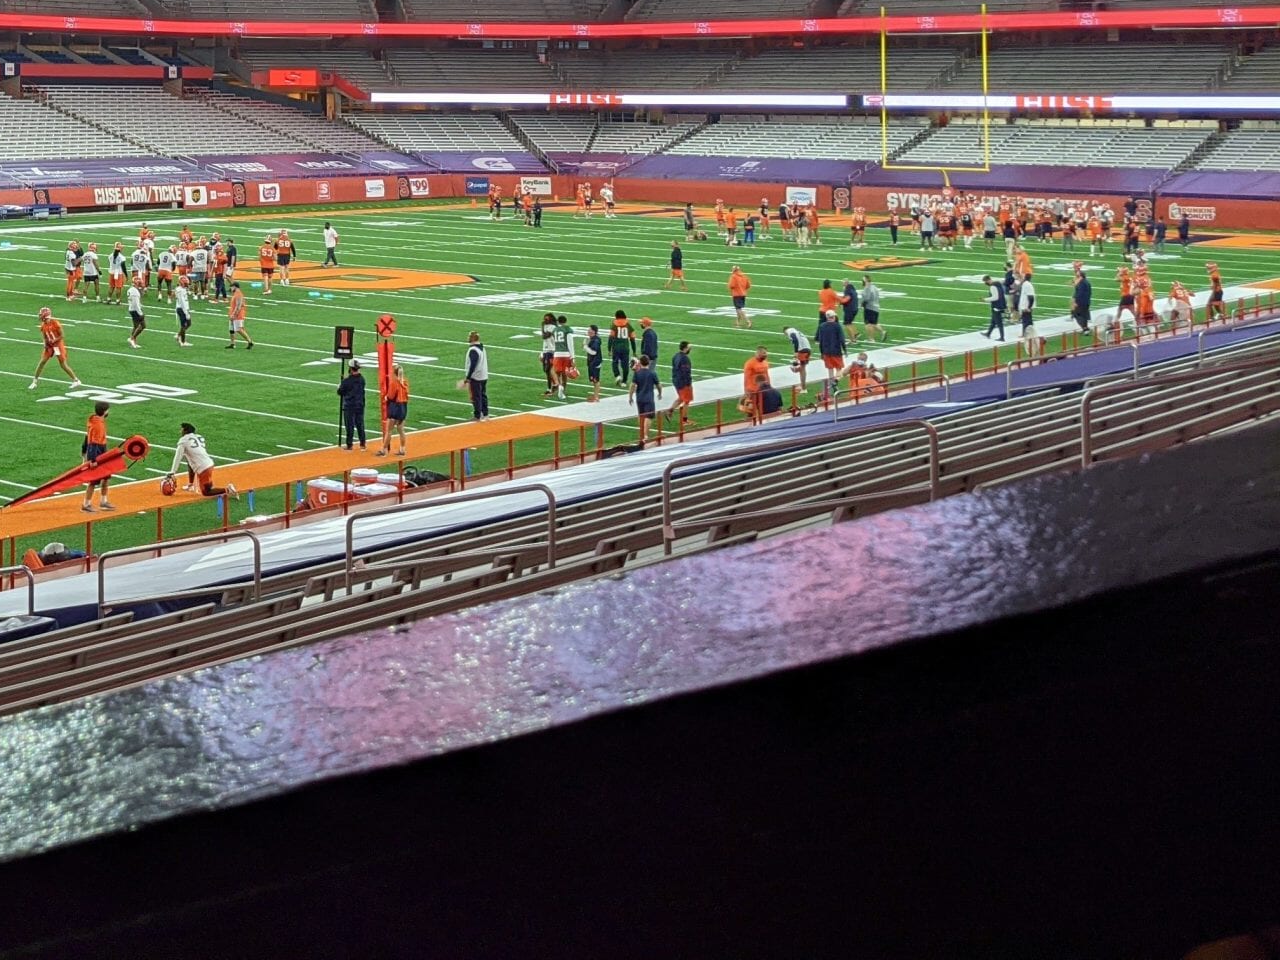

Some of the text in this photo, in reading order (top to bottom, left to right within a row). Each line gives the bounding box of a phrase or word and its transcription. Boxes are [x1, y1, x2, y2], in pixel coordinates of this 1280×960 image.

[522, 179, 550, 187] KeyBank
[261, 249, 272, 257] 53
[45, 330, 56, 341] 11
[554, 331, 564, 342] 12
[617, 327, 628, 338] 10
[340, 329, 349, 348] 1
[318, 491, 329, 505] G
